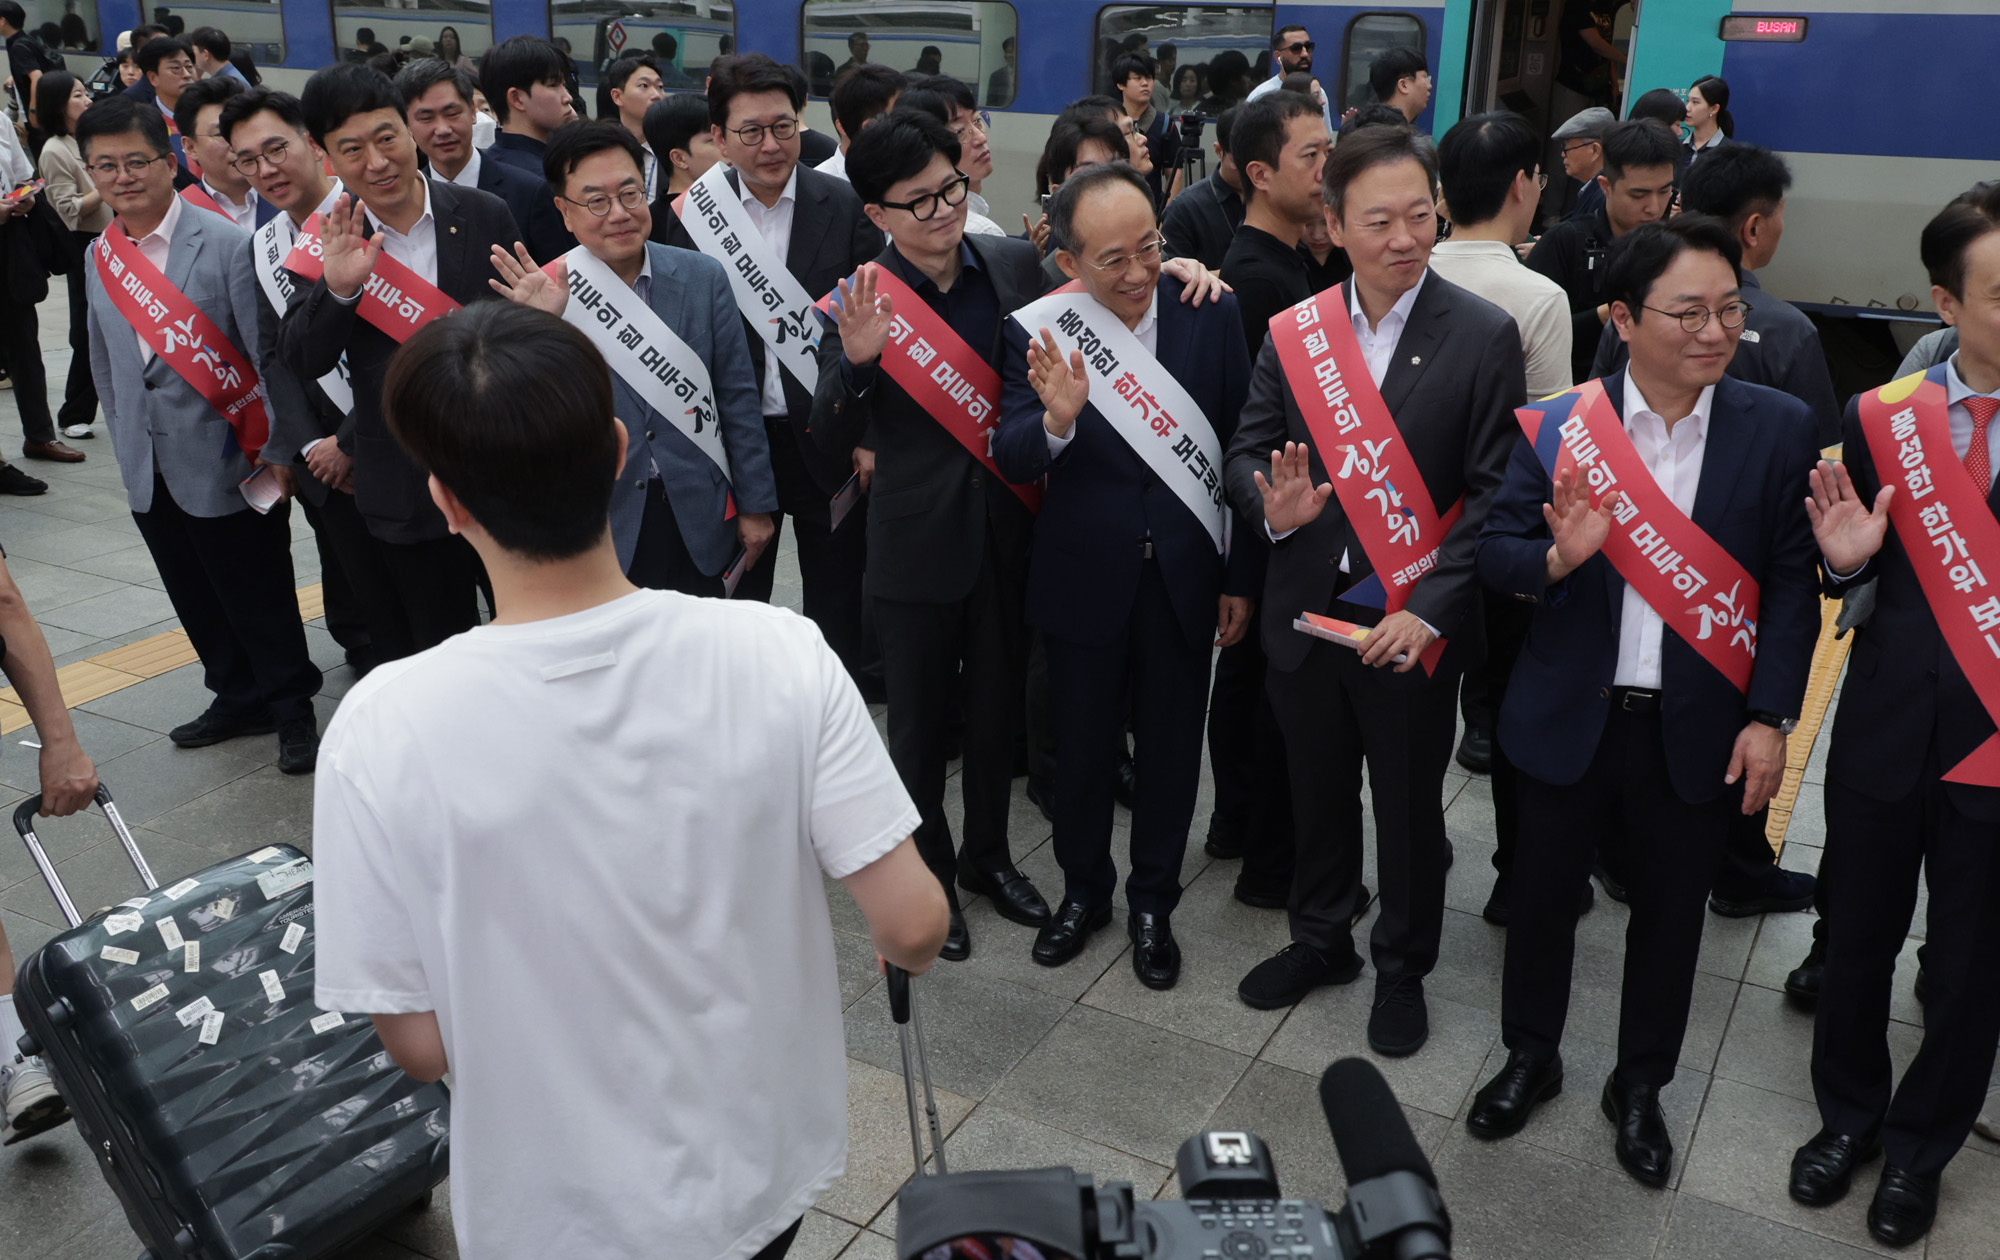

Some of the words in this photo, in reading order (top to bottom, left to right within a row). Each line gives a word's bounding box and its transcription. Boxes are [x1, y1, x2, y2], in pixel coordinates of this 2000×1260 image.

[1756, 21, 1797, 33] BUSAN
[265, 221, 277, 245] 의
[266, 243, 279, 265] 힘
[688, 181, 728, 236] 모두의
[720, 232, 742, 256] 힘
[735, 253, 784, 312] 모두의
[108, 254, 126, 278] 힘
[121, 271, 170, 323] 모두의
[155, 314, 242, 390] 한가위
[568, 269, 623, 330] 모두의
[616, 323, 644, 351] 힘
[638, 345, 698, 404] 모두의
[1302, 328, 1330, 359] 힘
[906, 336, 937, 368] 힘
[930, 360, 993, 424] 모두의
[1056, 308, 1119, 378] 풍성한
[1112, 371, 1179, 437] 한가위
[1171, 433, 1223, 513] 보내세요
[1313, 356, 1362, 436] 모두의
[1335, 437, 1420, 547] 한가위
[1558, 414, 1618, 496] 모두의
[1629, 521, 1708, 599] 모두의
[1684, 579, 1757, 659] 한가
[1889, 406, 1935, 500] 풍성한
[1918, 501, 1987, 594] 한가위
[285, 863, 311, 878] HEAVY
